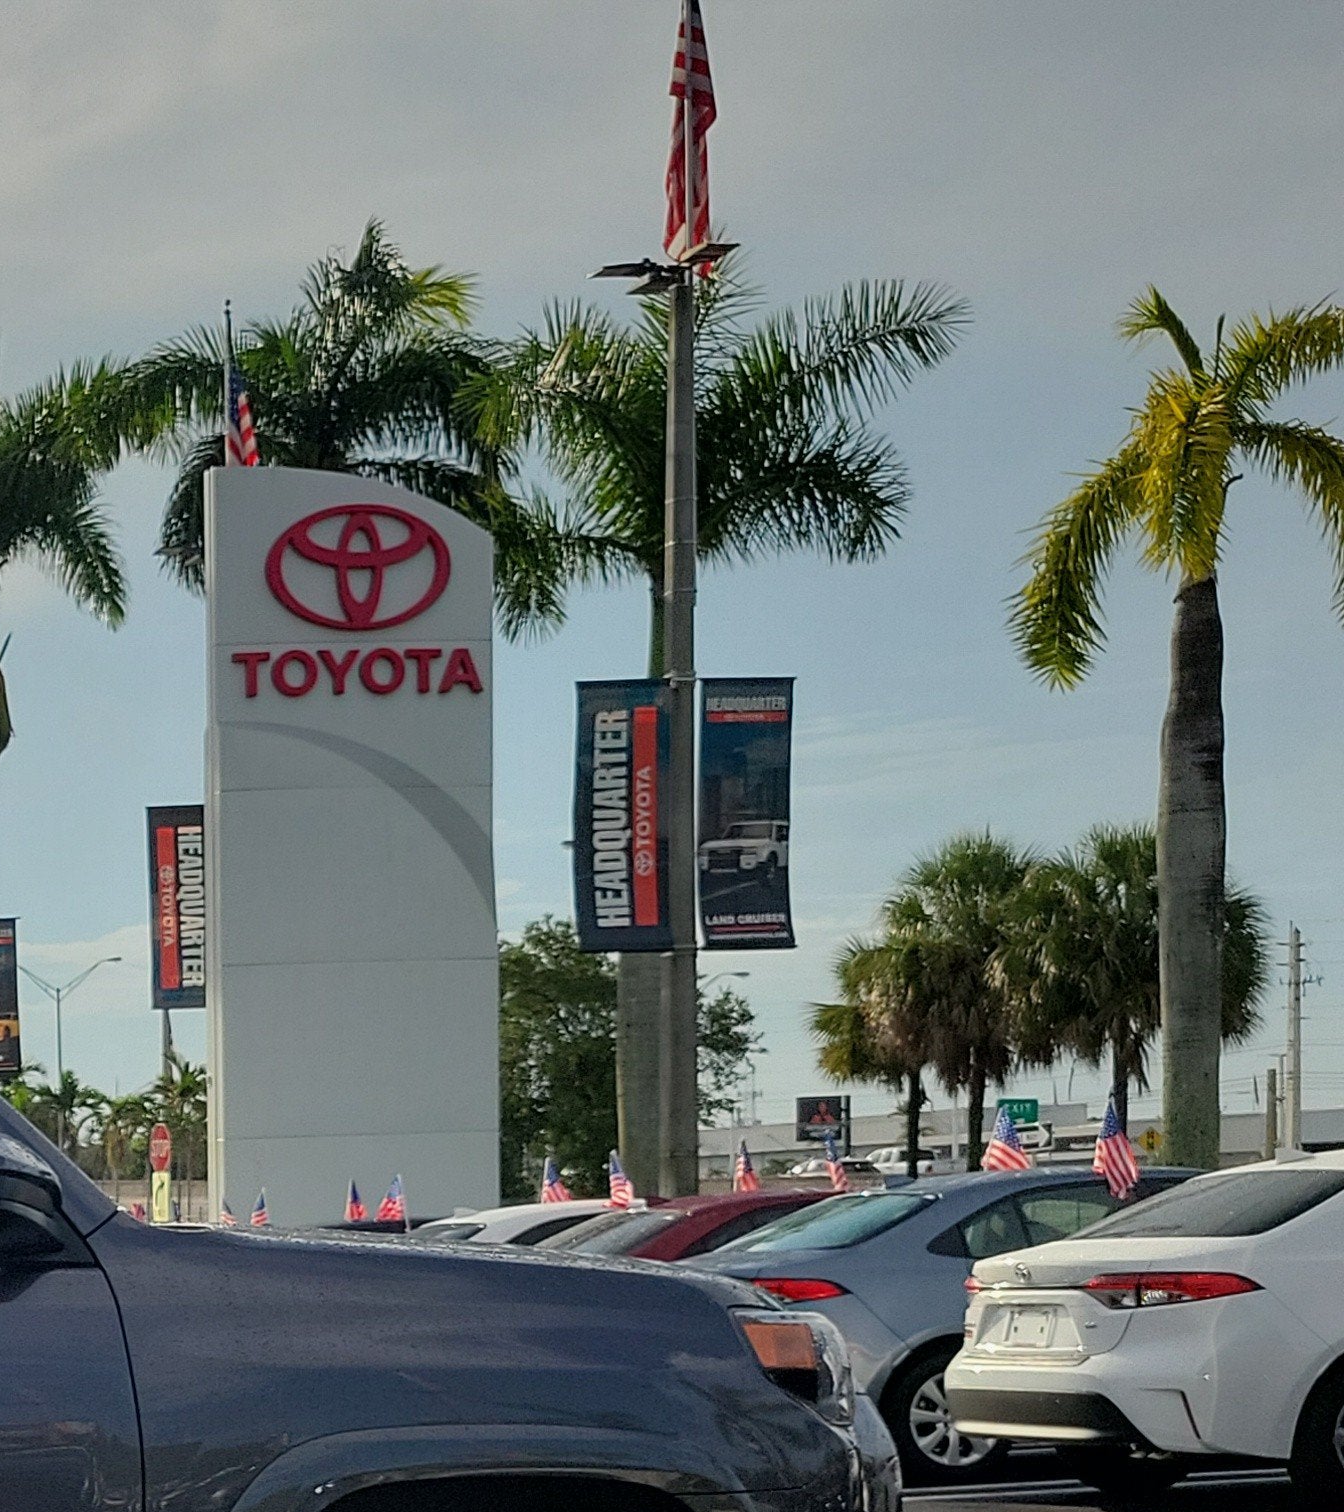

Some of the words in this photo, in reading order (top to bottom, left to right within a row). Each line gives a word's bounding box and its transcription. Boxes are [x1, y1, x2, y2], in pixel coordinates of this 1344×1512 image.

[230, 647, 484, 698] TOYOTA
[592, 709, 632, 928] HEADQUARTER
[635, 765, 652, 848] TOYOTA
[161, 885, 176, 948] TOYOTA
[176, 825, 206, 988] HEADQUARTER
